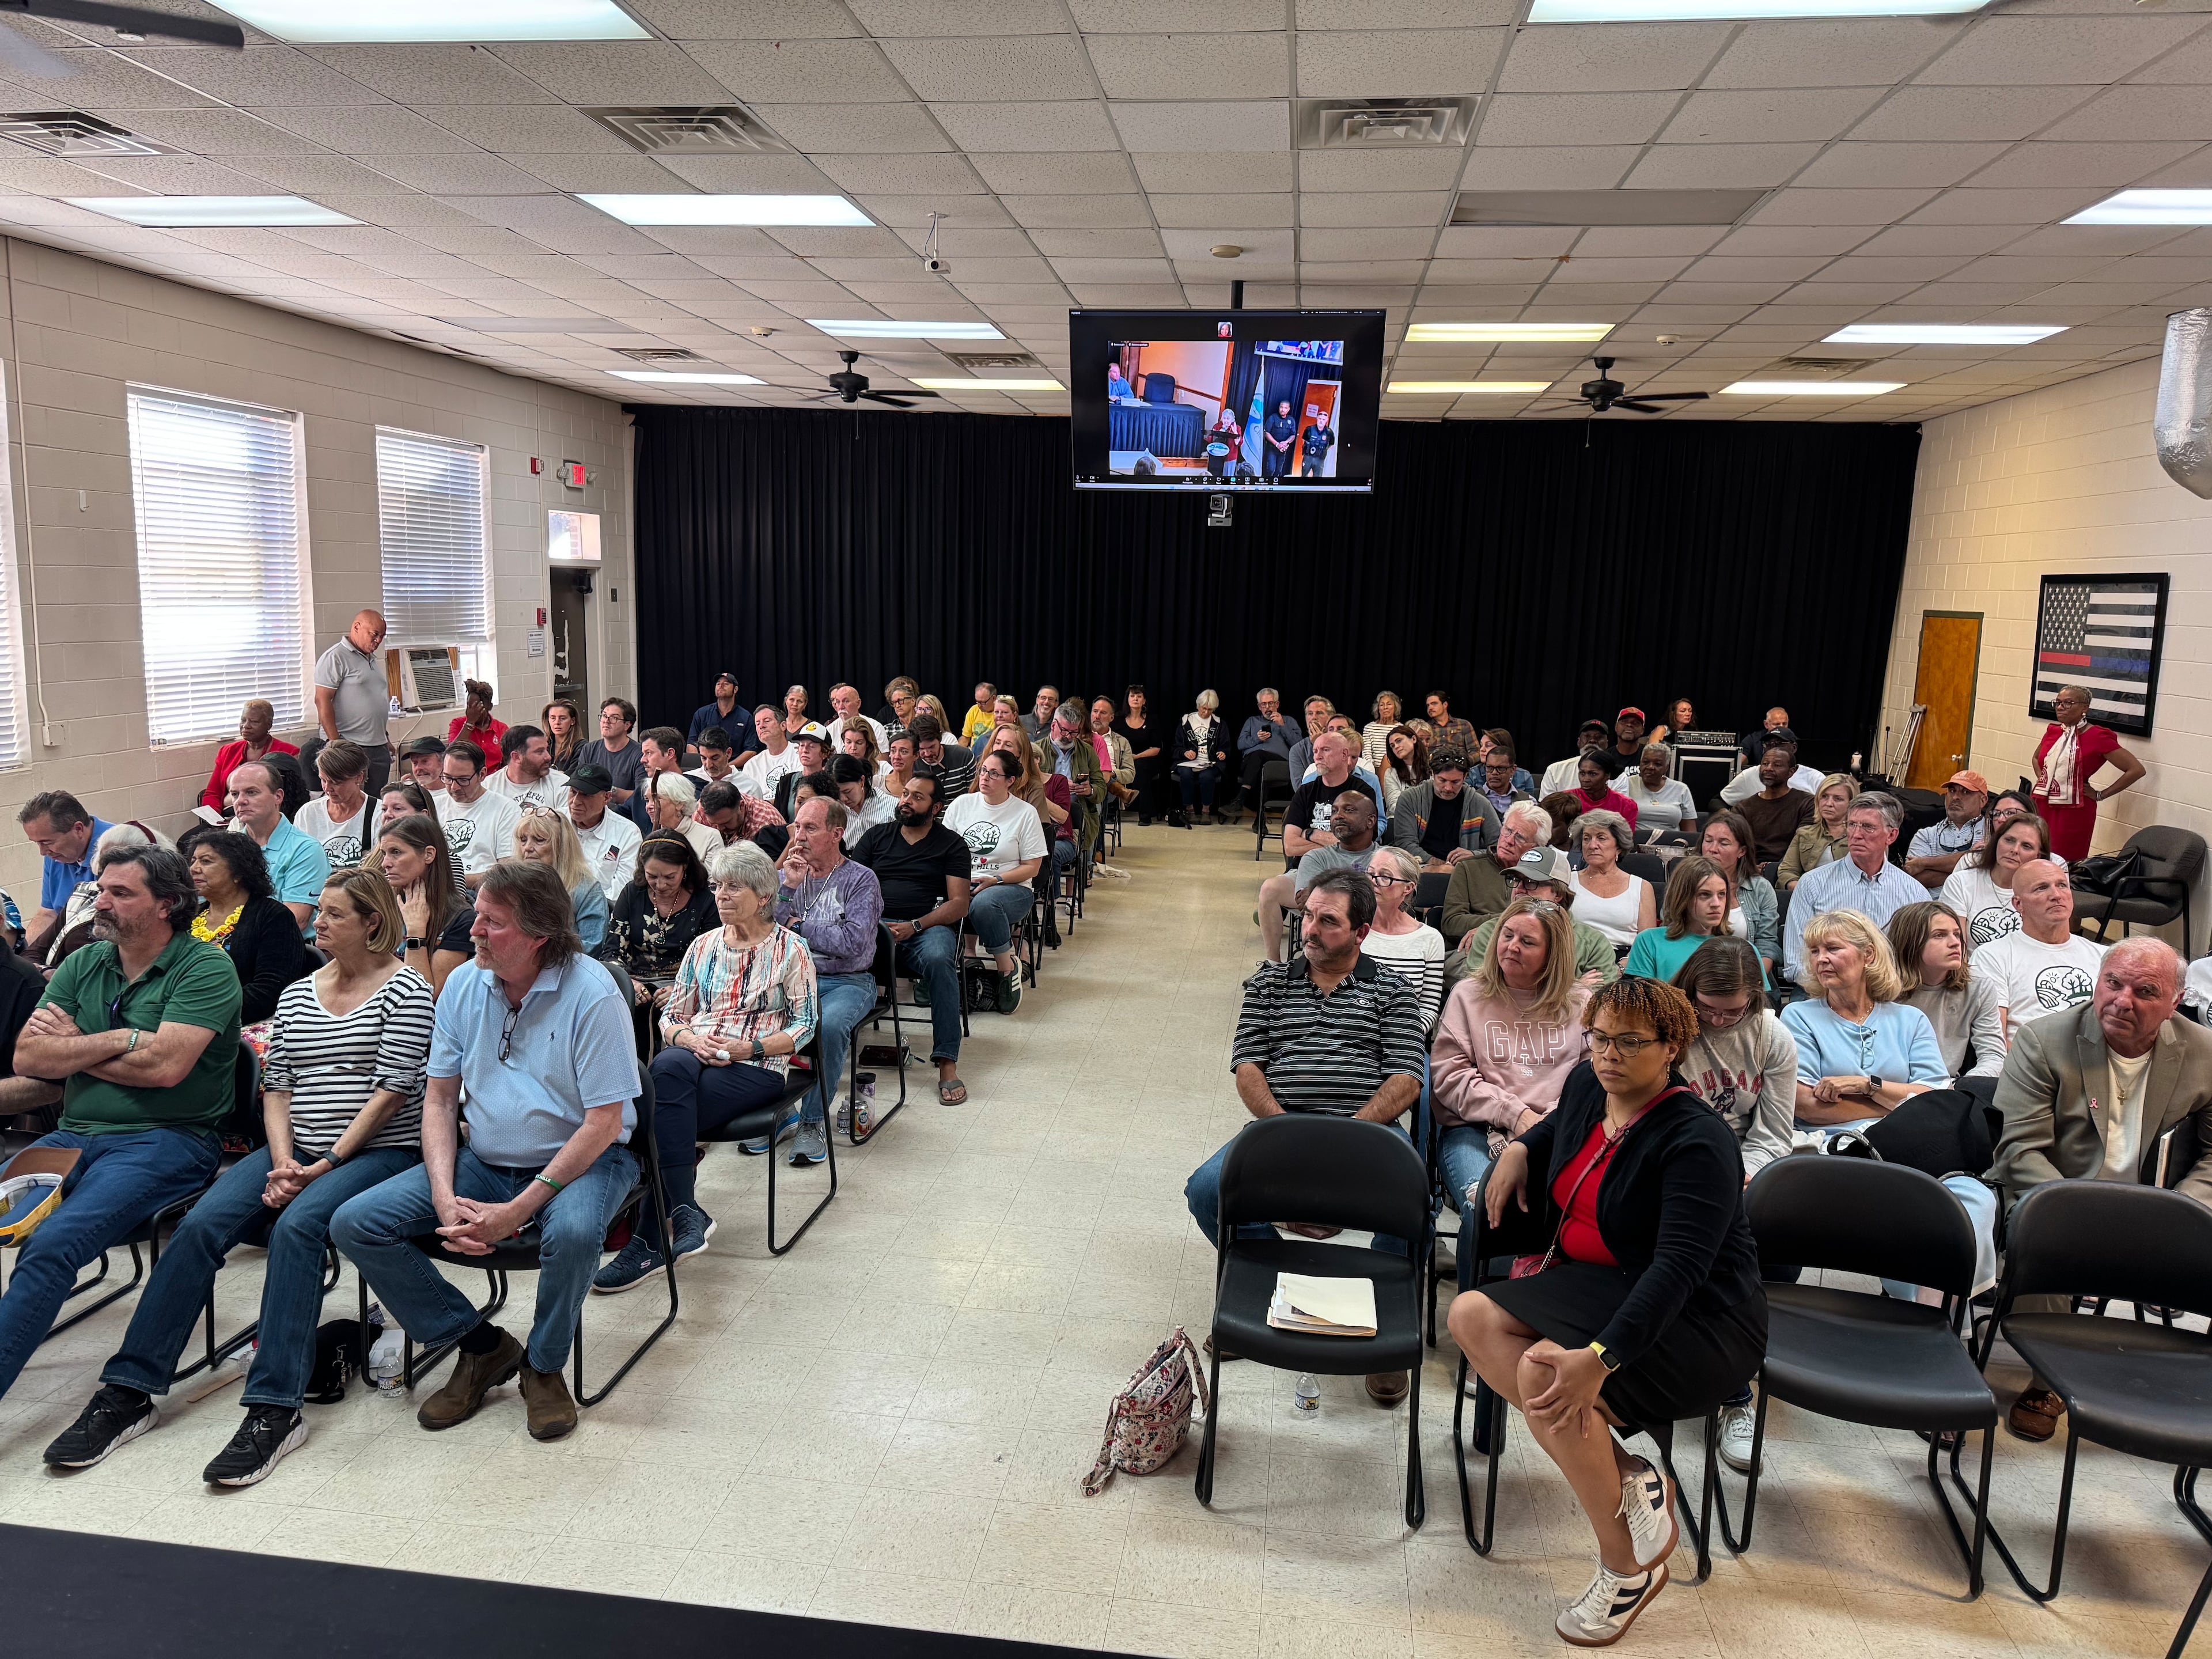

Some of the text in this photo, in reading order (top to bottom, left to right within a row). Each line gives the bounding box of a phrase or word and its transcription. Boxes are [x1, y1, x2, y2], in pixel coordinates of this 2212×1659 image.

[1624, 765, 1641, 776] ACK
[1484, 1020, 1566, 1065] GAP
[1521, 1068, 1533, 1077] 1969
[1689, 1067, 1762, 1098] OUGAR
